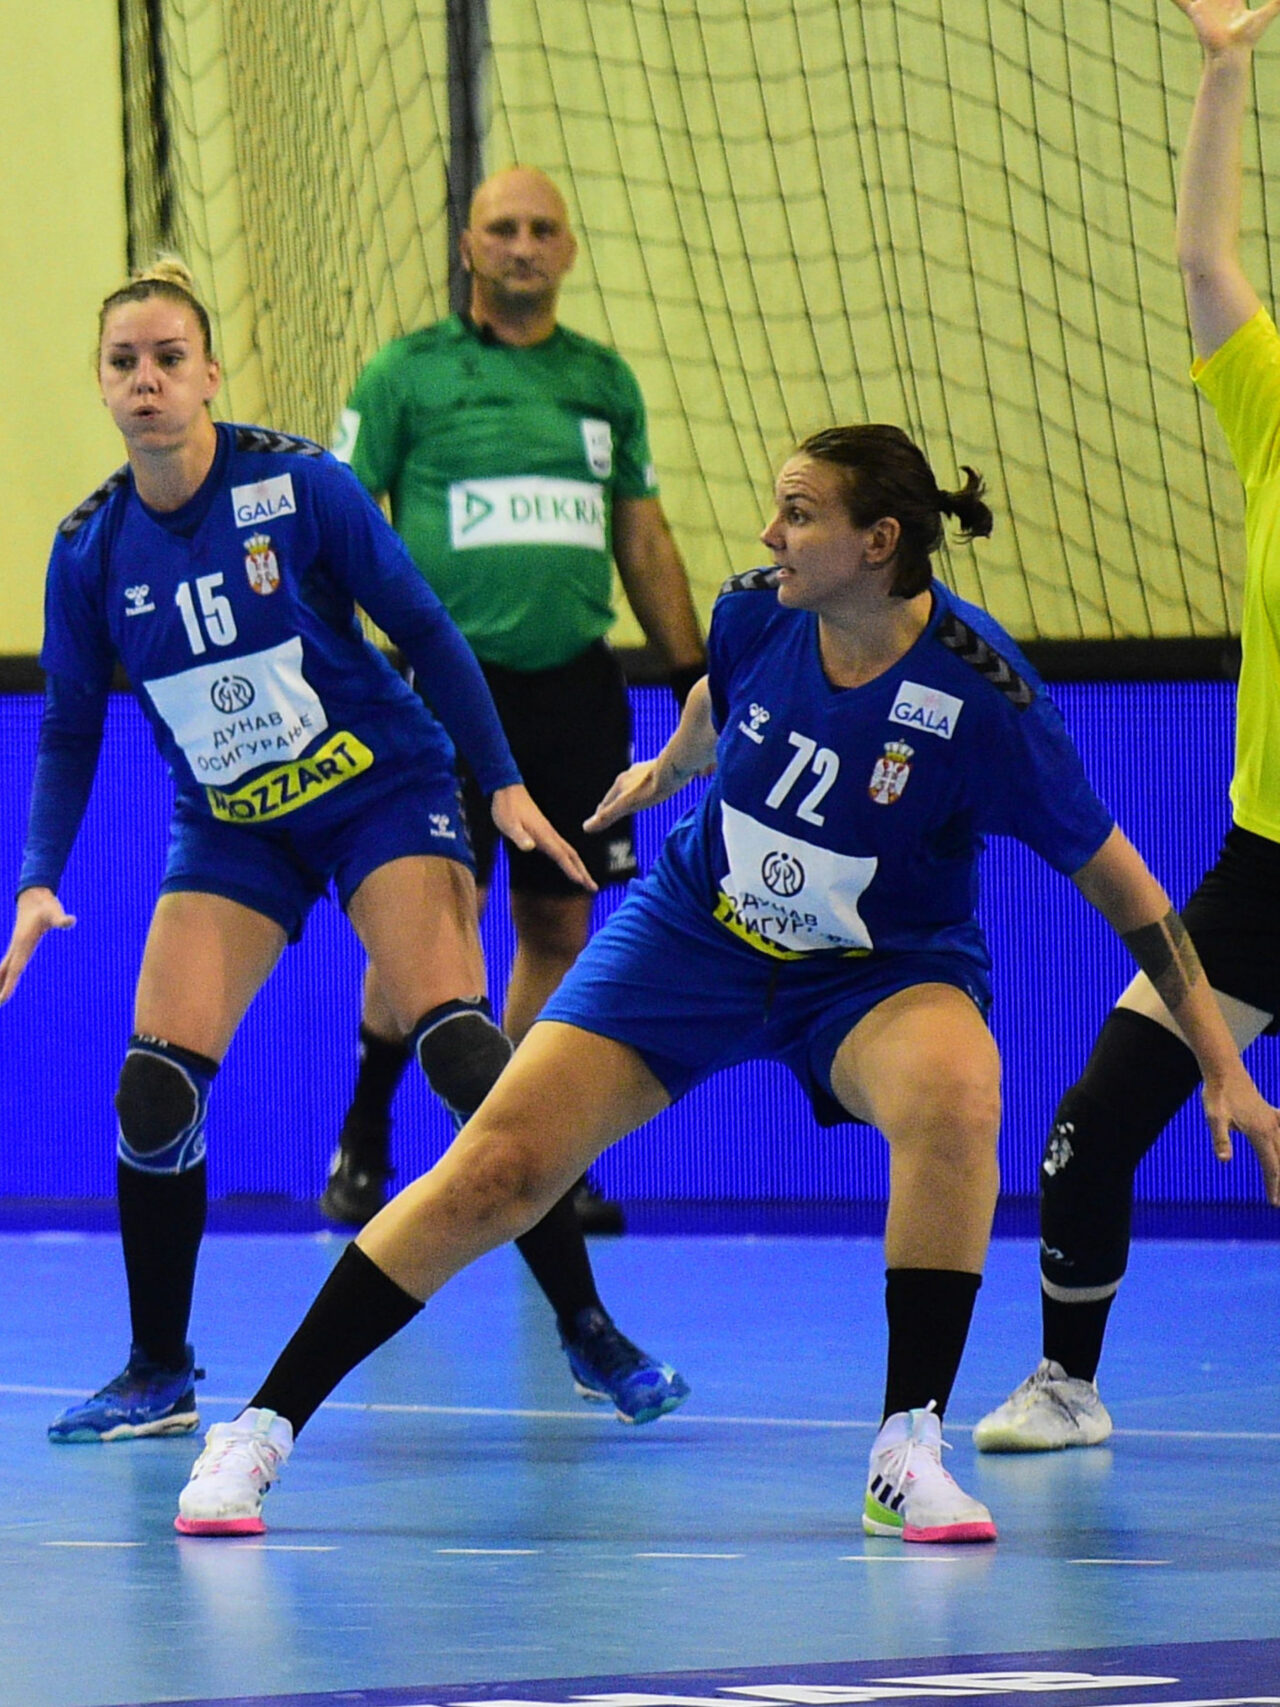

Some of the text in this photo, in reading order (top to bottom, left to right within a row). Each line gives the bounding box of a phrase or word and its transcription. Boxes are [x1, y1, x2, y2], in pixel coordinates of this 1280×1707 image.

[237, 494, 292, 522] GALA
[511, 495, 605, 527] DEKRA
[175, 571, 237, 656] 15
[213, 711, 284, 749] ДУНАВ
[894, 702, 950, 736] GALA
[197, 713, 313, 772] ОСИГУРАЊЕ
[765, 731, 840, 827] 72
